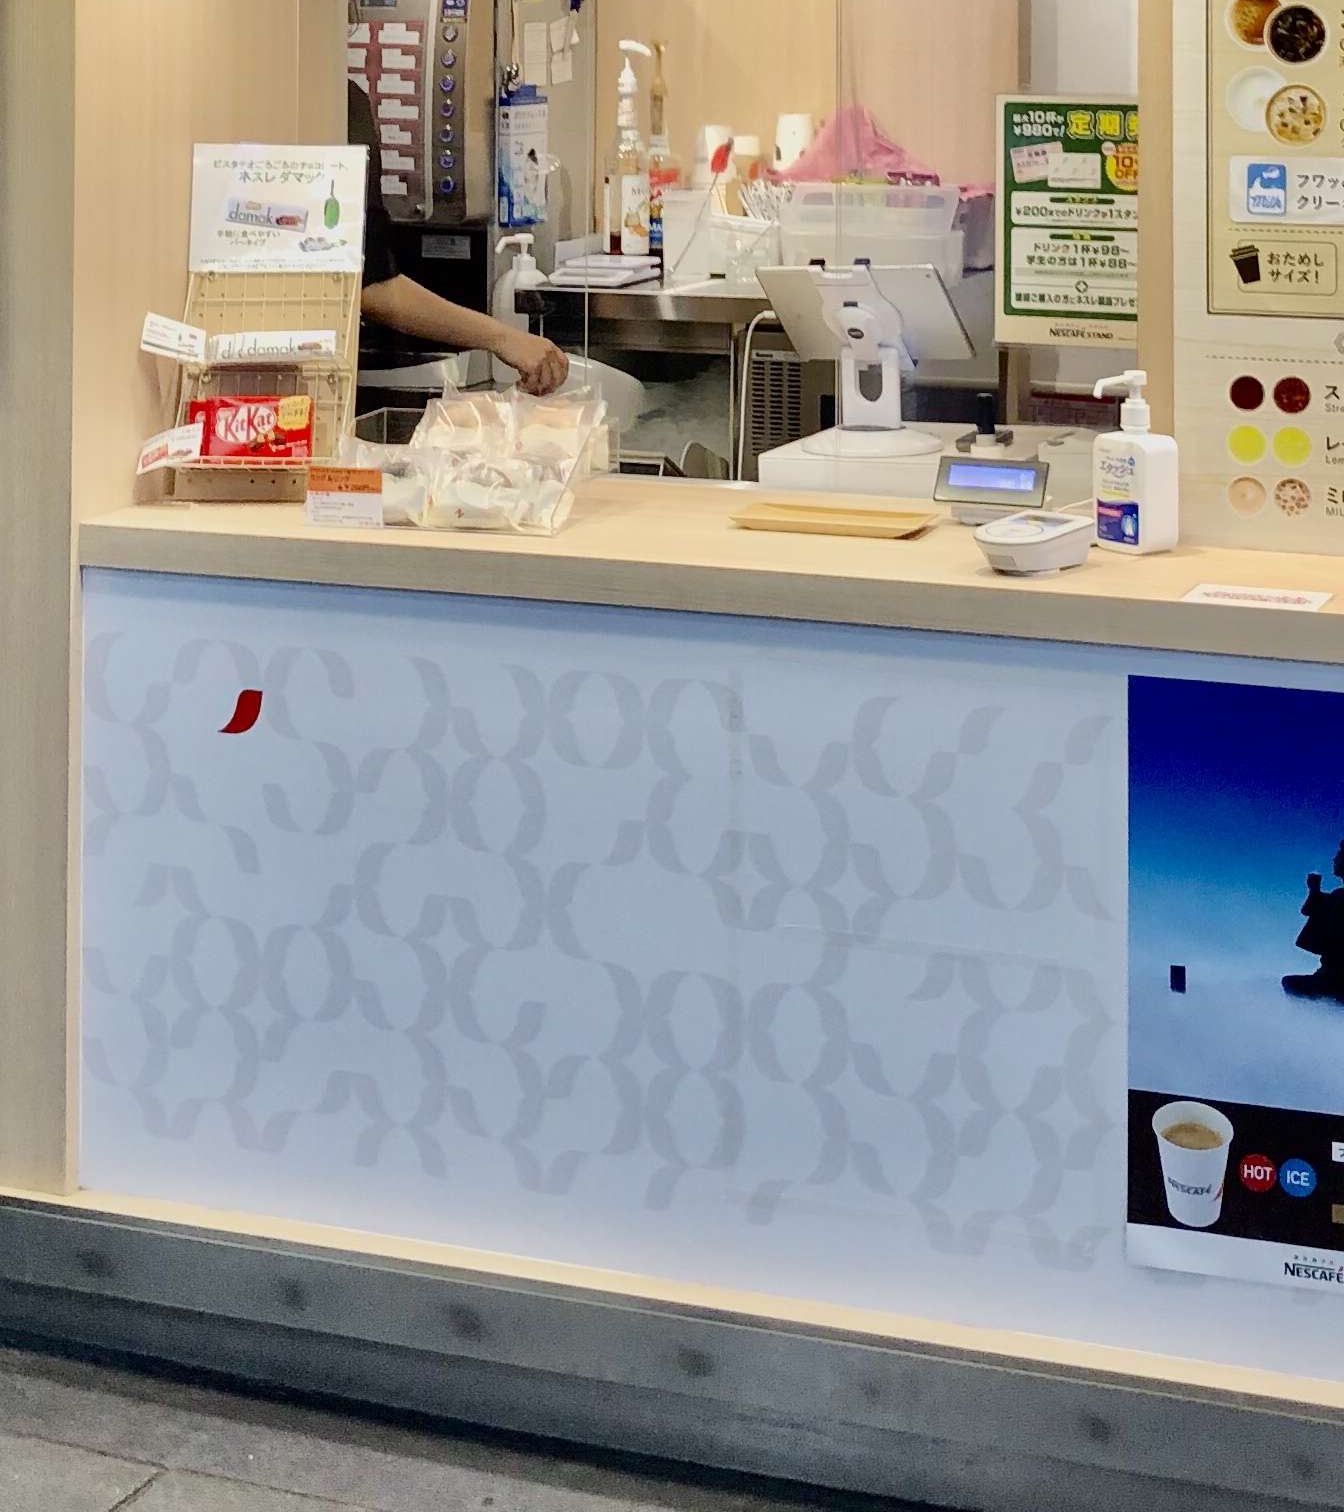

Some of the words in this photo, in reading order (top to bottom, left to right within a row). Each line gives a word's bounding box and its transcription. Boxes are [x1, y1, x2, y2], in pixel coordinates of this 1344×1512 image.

[1266, 251, 1325, 268] おためし
[1243, 1163, 1274, 1182] HOT
[1286, 1170, 1311, 1187] ICE
